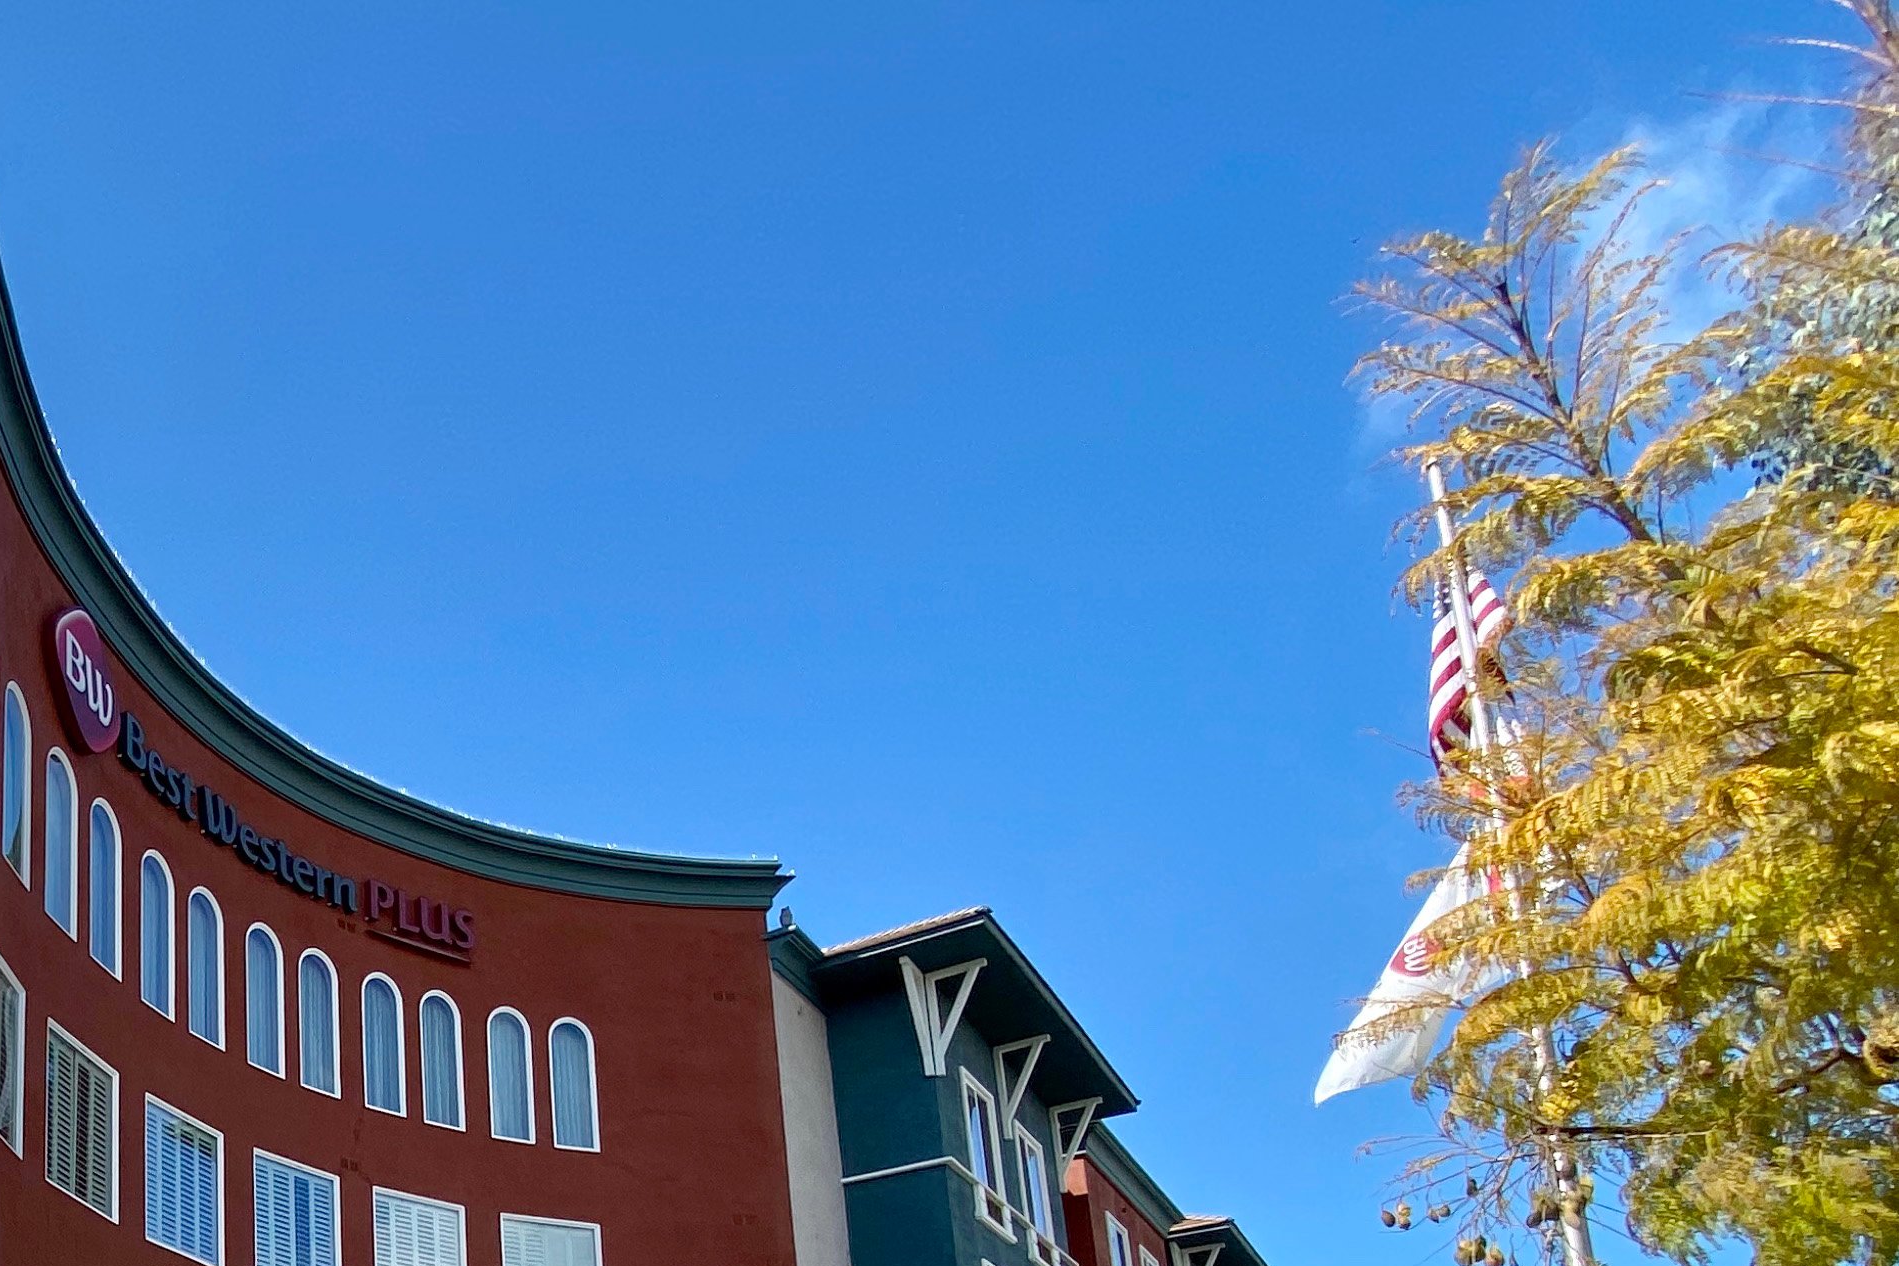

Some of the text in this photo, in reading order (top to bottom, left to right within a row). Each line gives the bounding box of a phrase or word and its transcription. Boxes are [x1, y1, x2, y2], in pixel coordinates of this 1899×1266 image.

[64, 629, 113, 726] BW
[121, 711, 475, 949] Best Western PLUS
